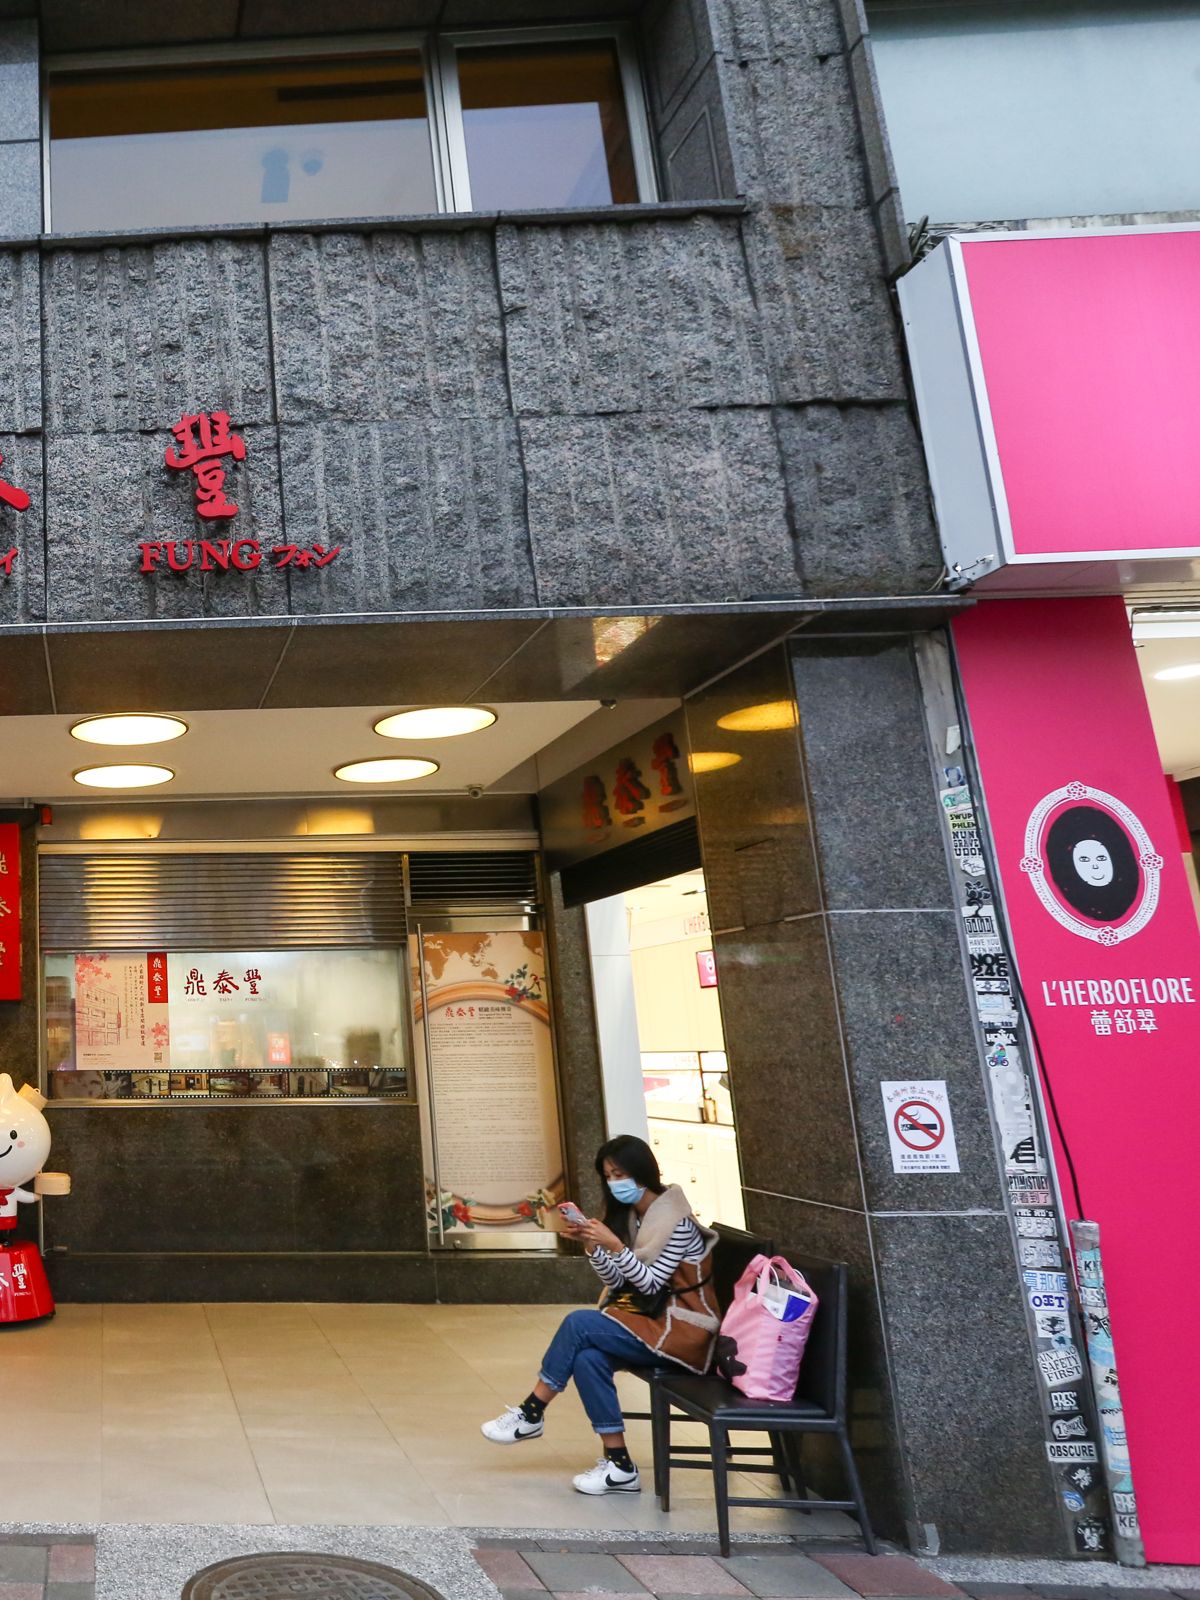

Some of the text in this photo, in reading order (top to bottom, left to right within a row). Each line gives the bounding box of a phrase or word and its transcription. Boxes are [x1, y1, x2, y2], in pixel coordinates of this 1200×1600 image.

[138, 539, 262, 573] FUNG
[273, 544, 341, 568] フォン
[184, 968, 262, 996] 鼎泰豐
[1042, 978, 1196, 1006] L'HERBOFLORE
[1090, 1009, 1158, 1036] 蕾舒翠
[1041, 1355, 1081, 1374] SAFETY
[1047, 1366, 1082, 1382] FIRST
[1049, 1444, 1095, 1457] OBSCURE
